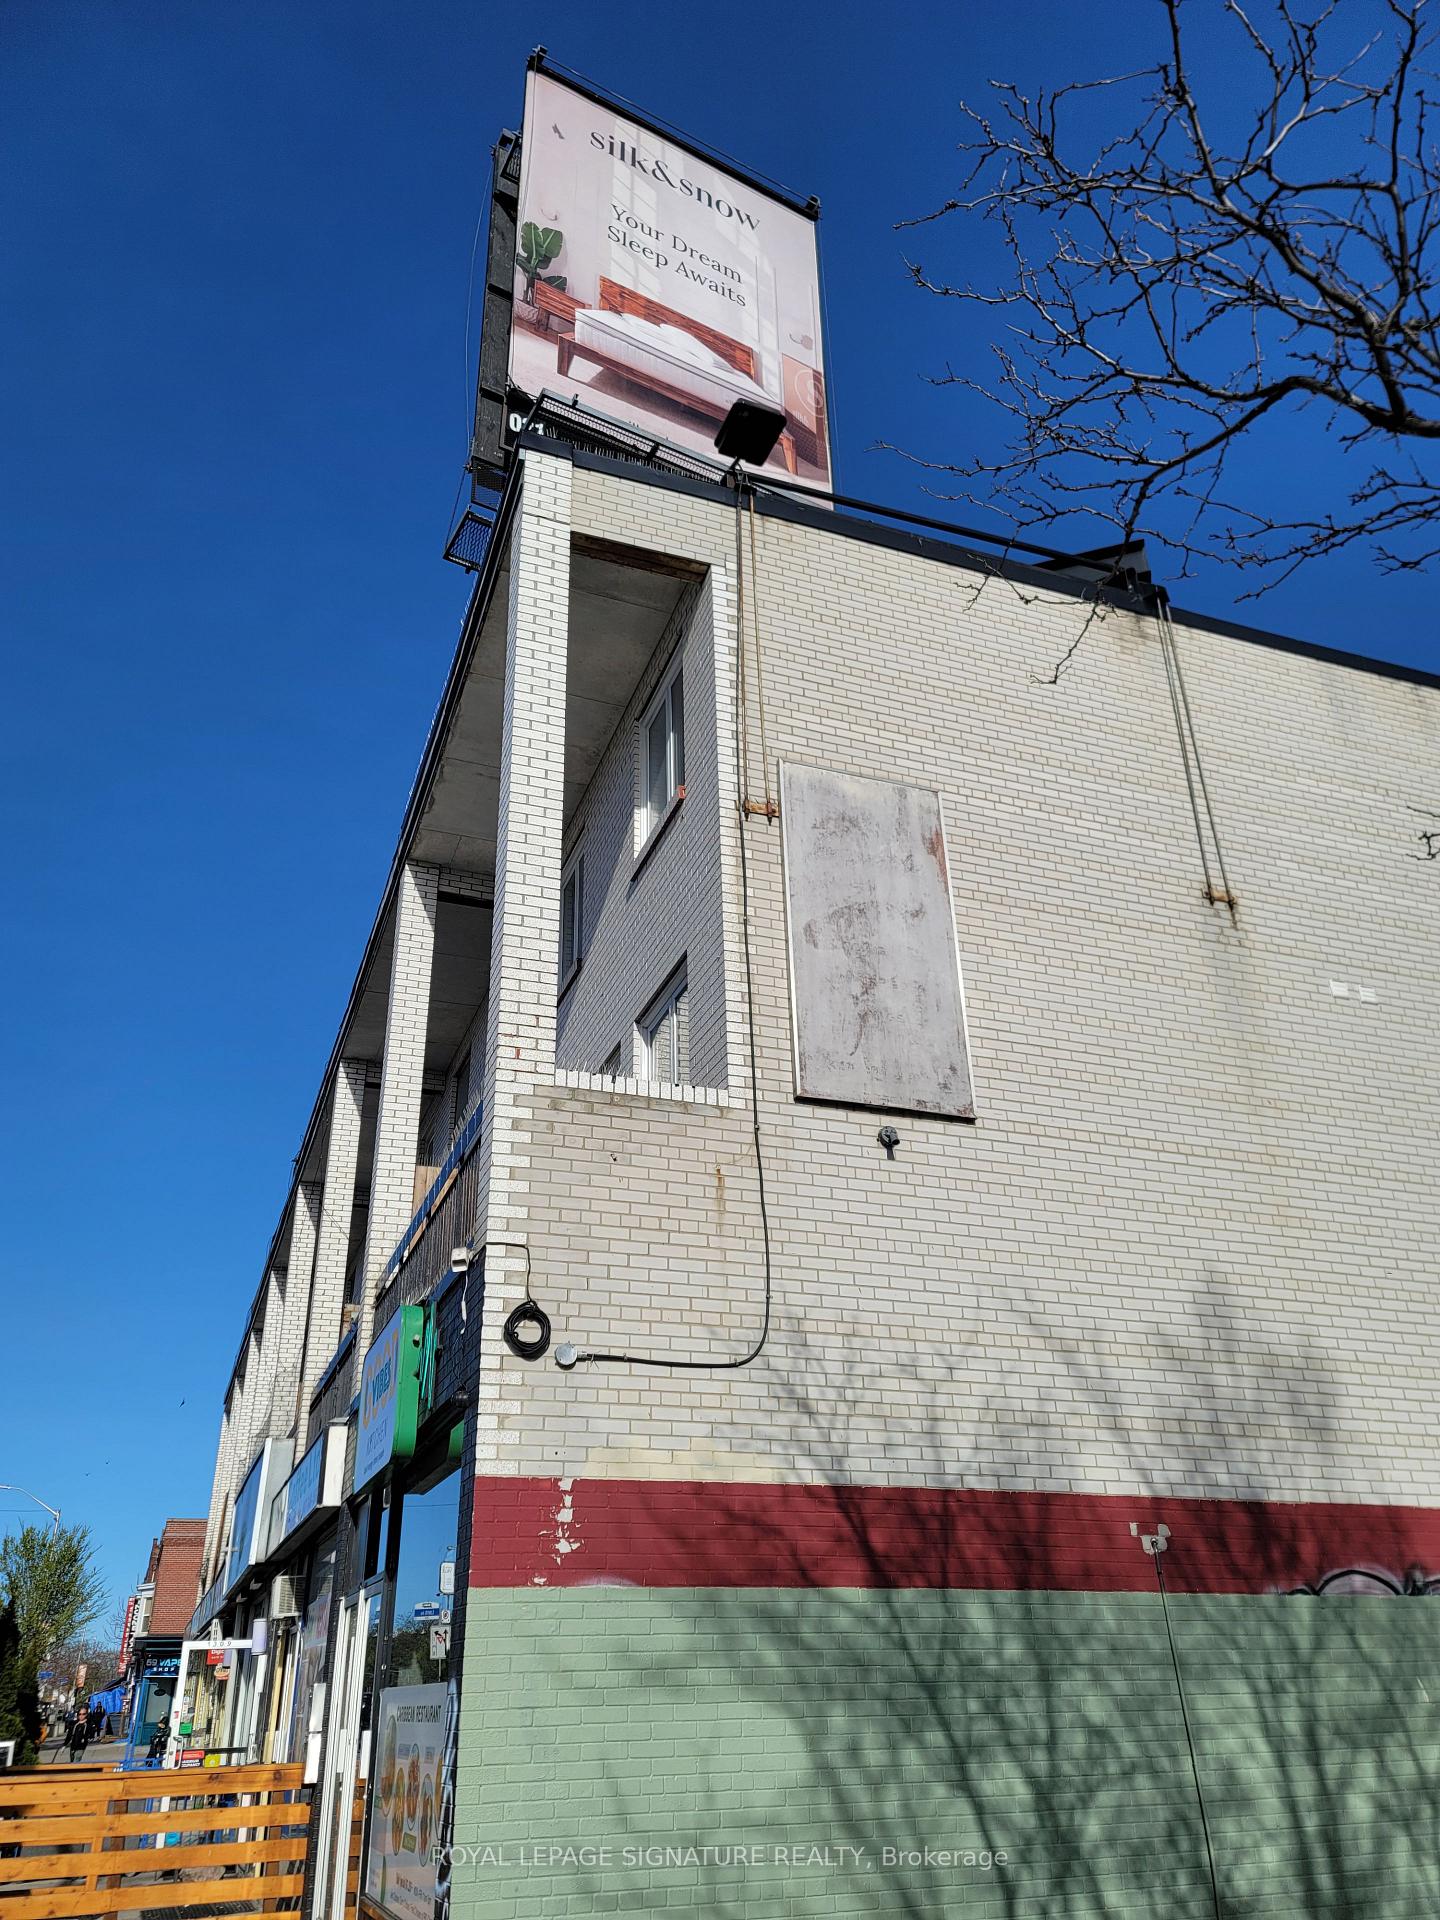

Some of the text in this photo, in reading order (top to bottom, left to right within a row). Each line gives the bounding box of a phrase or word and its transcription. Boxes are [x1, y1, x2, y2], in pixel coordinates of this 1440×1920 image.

[590, 131, 760, 231] silk&snow
[608, 225, 746, 307] Sleep Awaits
[611, 203, 743, 284] Your Dream
[397, 1704, 441, 1723] CARIBBEAN RESTAURANT
